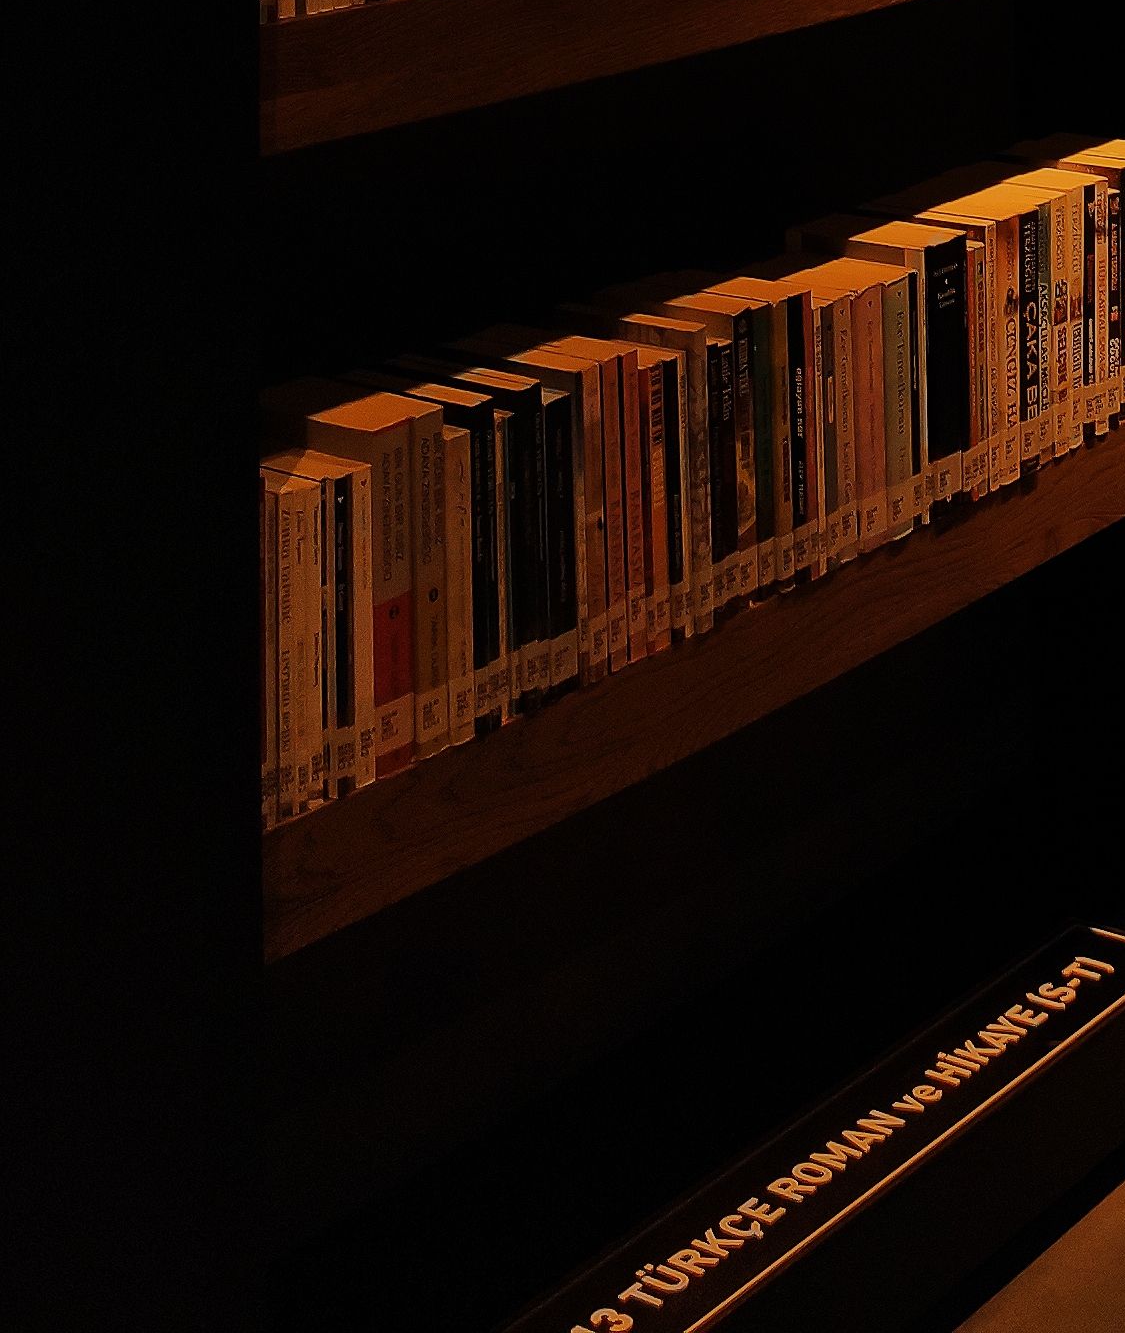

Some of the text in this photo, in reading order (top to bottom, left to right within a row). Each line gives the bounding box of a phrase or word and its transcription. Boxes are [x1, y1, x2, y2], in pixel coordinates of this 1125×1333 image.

[1005, 399, 1017, 430] HA
[1026, 382, 1037, 423] BE
[618, 1197, 787, 1309] TÜRKÇE
[767, 1109, 906, 1204] ROMAN
[892, 1085, 943, 1113] ve
[925, 1004, 1049, 1087] HİKAYE
[1026, 957, 1114, 1010] (S-T)
